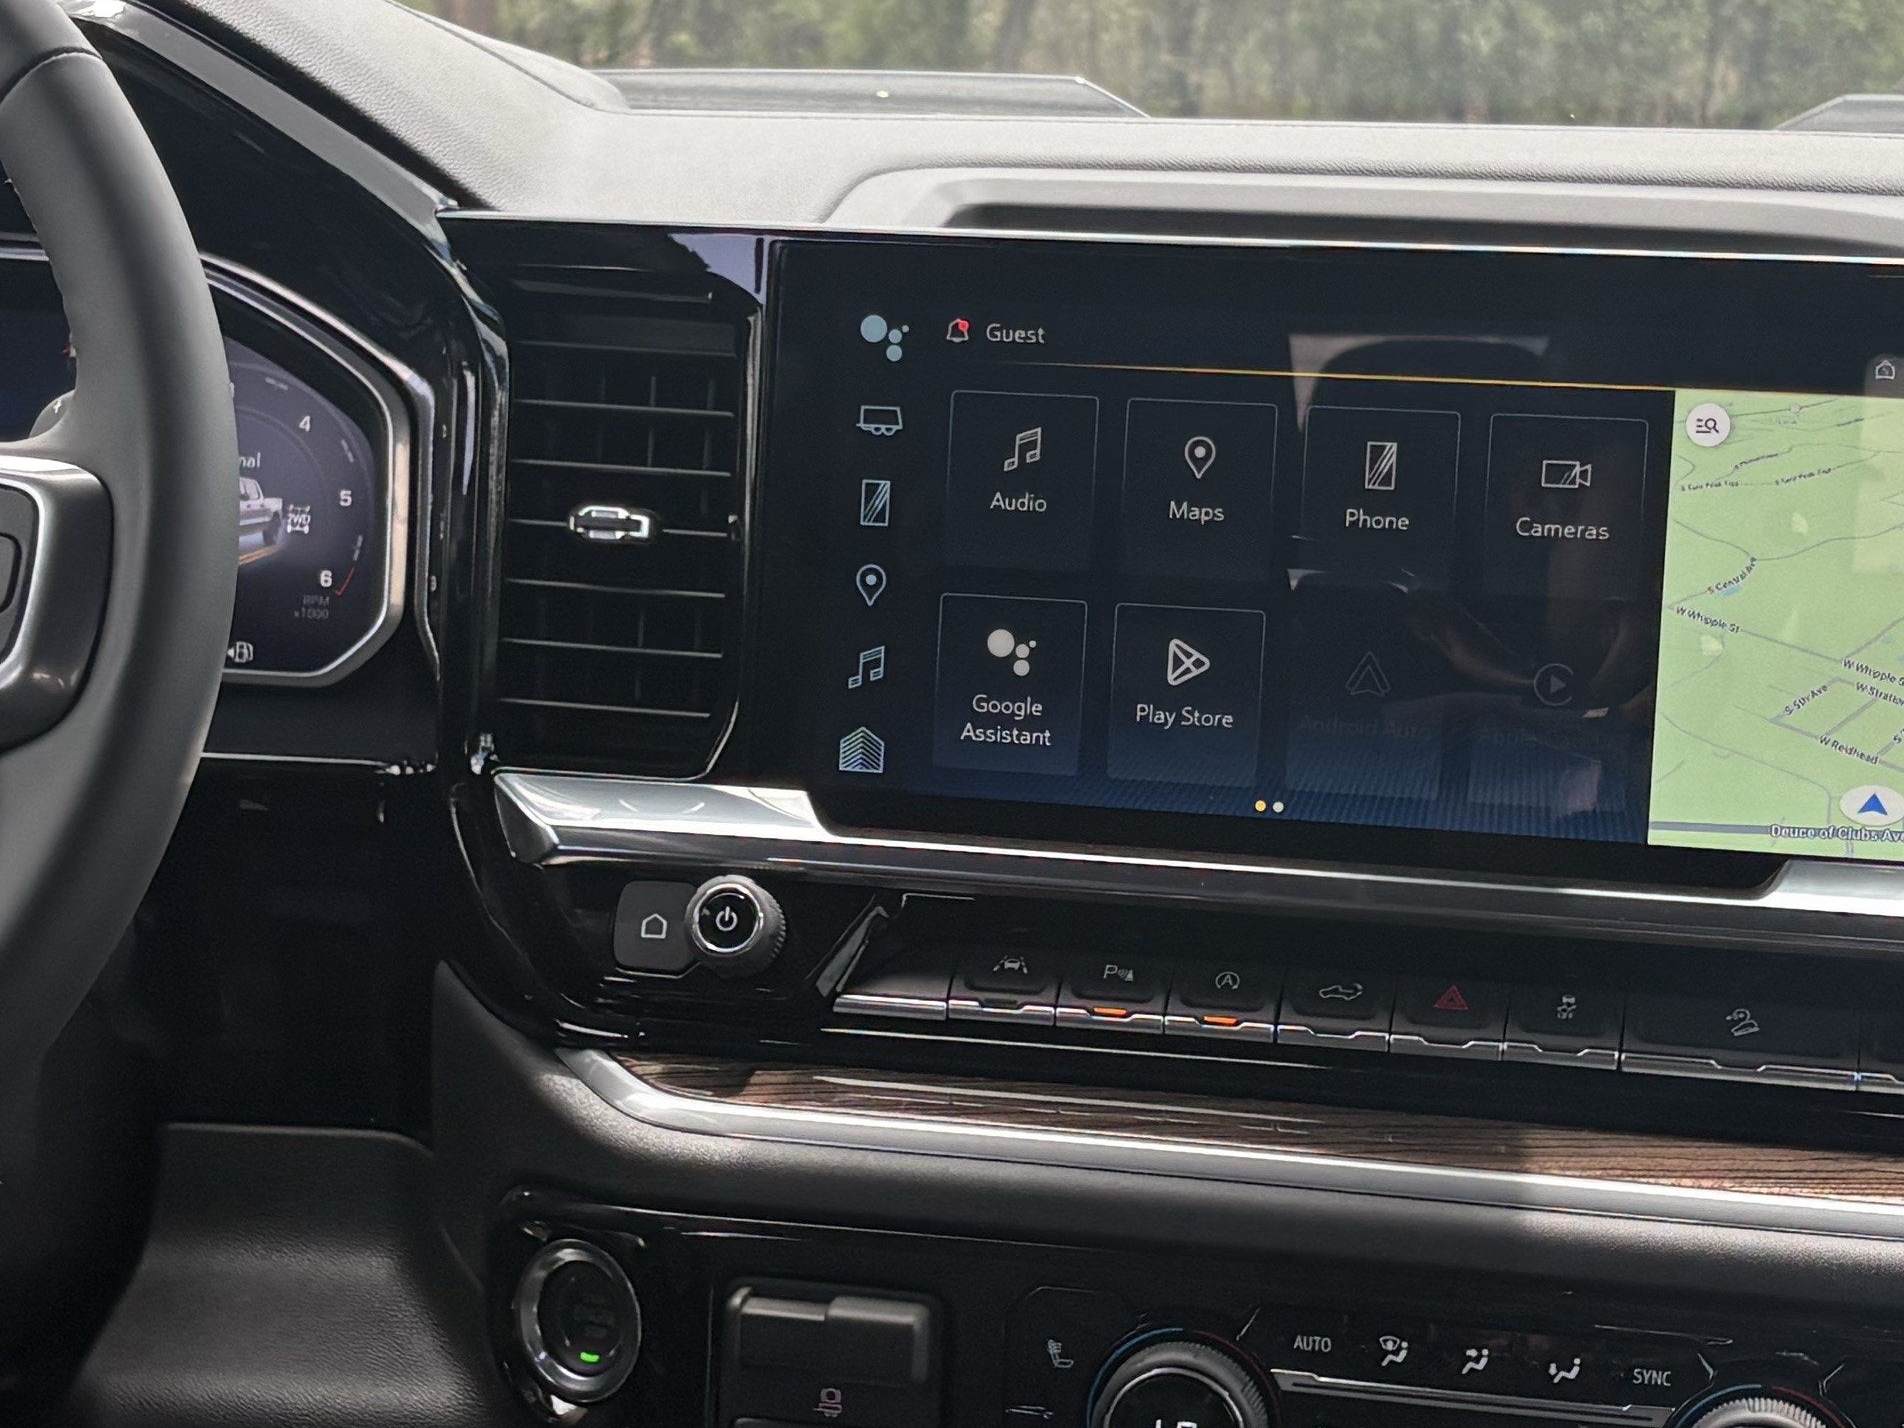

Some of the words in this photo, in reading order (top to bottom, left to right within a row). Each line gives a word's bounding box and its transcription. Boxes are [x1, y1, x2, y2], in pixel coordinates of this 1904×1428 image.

[986, 323, 1045, 345] Guest
[299, 415, 311, 432] 4
[339, 489, 352, 507] 5
[990, 492, 1047, 513] Audio
[1169, 501, 1225, 524] Maps
[1345, 509, 1410, 531] Phone
[1516, 517, 1610, 541] Cameras
[319, 570, 333, 587] 6
[972, 694, 1043, 719] Google
[1136, 703, 1176, 729] Play
[1181, 706, 1235, 728] Store
[960, 723, 1052, 747] Assistant
[1770, 825, 1815, 839] Deuce
[1818, 825, 1836, 839] of
[1838, 827, 1879, 841] Clubs
[1294, 1335, 1331, 1353] AUTO
[1633, 1367, 1672, 1387] SYNC
